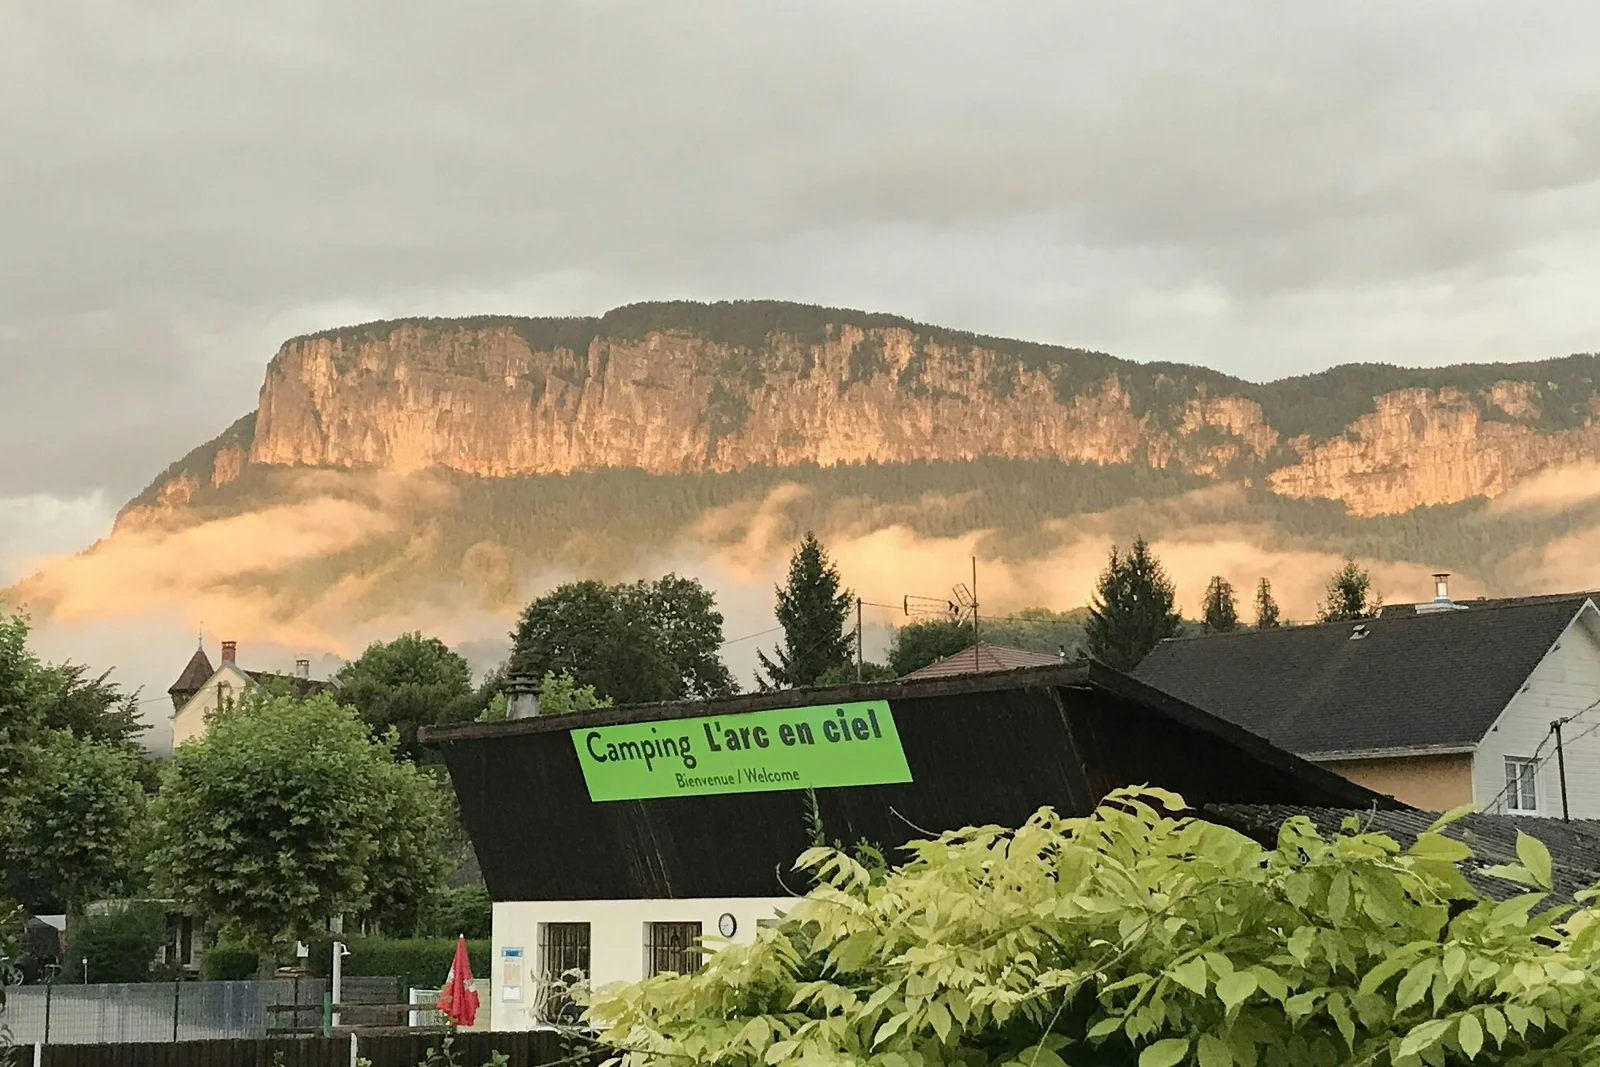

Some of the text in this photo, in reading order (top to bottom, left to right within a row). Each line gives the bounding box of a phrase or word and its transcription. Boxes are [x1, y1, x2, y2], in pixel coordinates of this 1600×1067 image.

[586, 708, 882, 771] Camping L'arc en ciel
[675, 772, 735, 788] Bienvenue
[743, 768, 800, 783] Welcome
